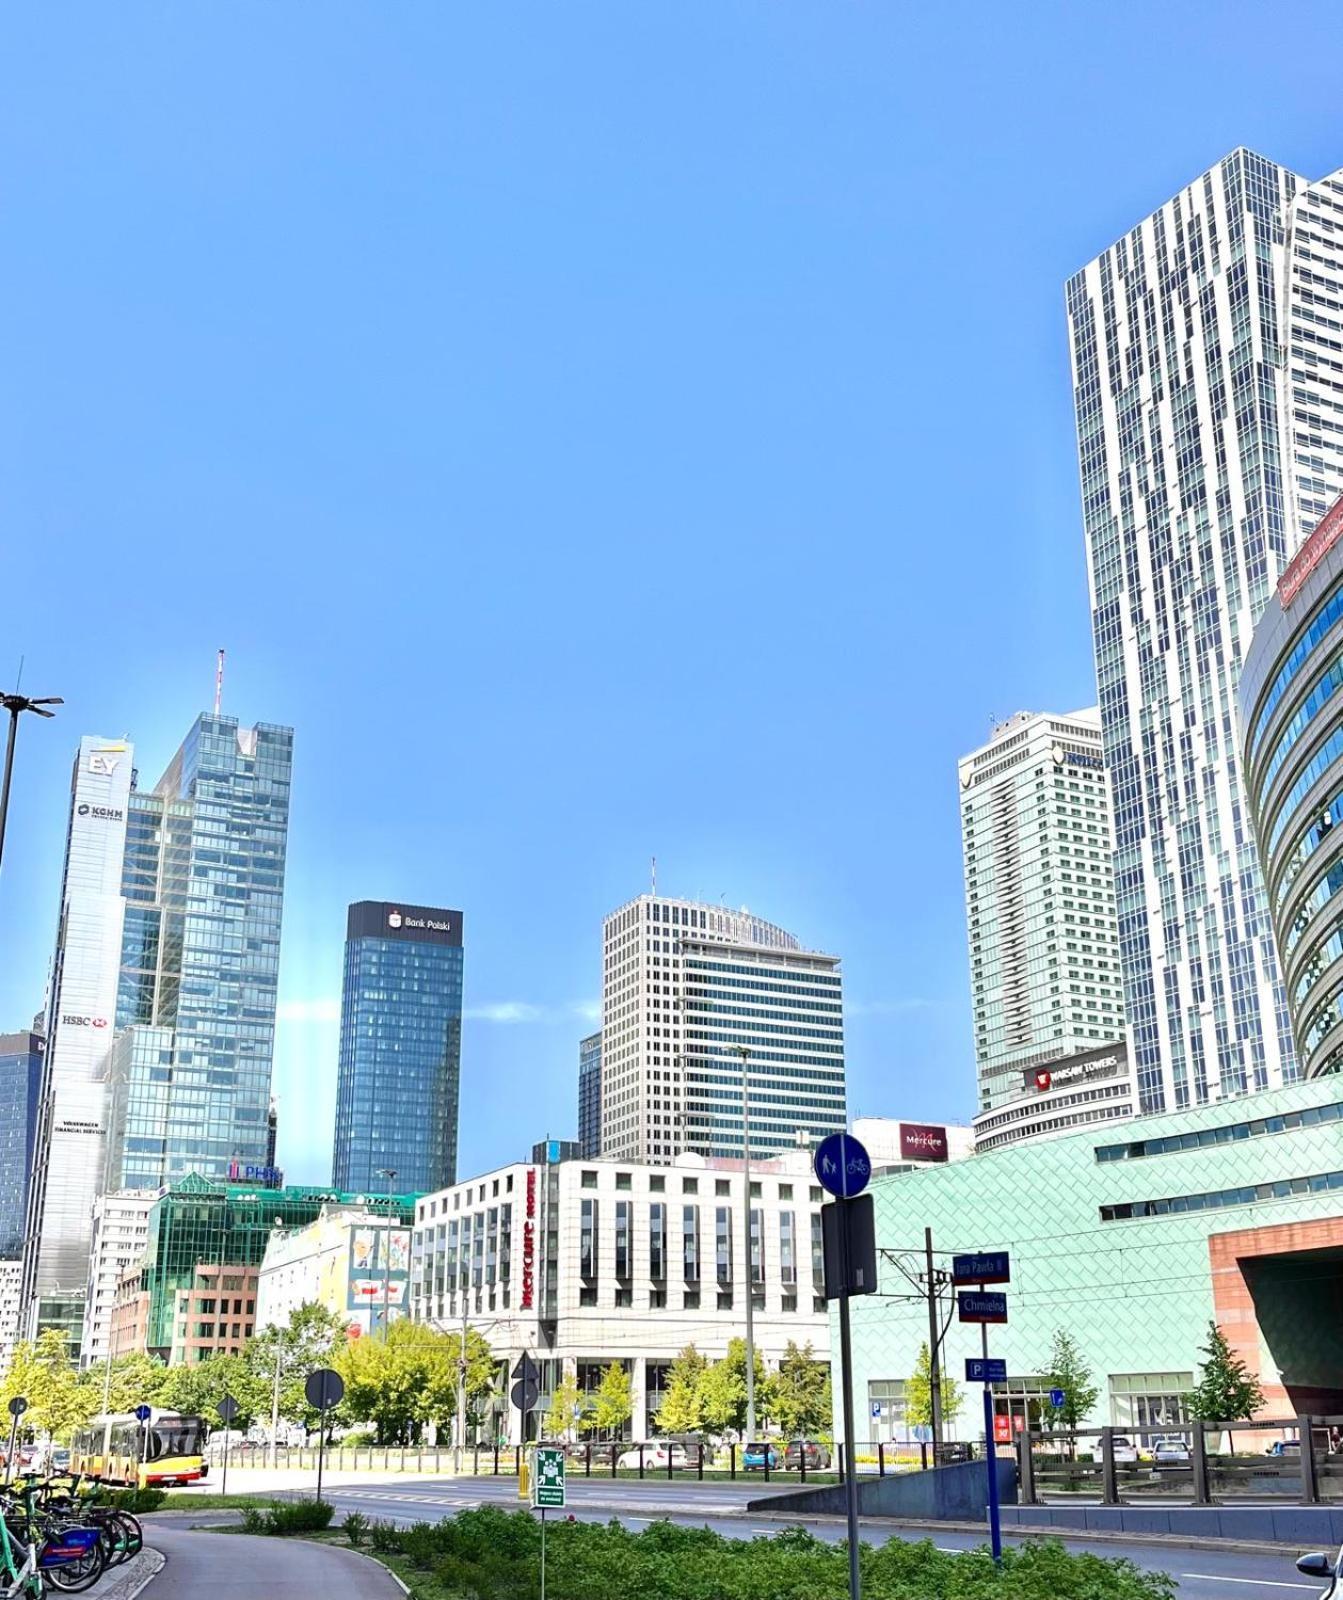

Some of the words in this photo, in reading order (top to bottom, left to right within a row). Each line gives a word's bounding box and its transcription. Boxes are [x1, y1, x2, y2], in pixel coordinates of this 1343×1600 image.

[89, 755, 120, 776] EY
[92, 806, 123, 818] KGHM
[405, 916, 426, 928] Bank
[427, 919, 451, 931] Polski
[62, 1015, 91, 1026] HSBC
[1050, 1064, 1083, 1081] WARSAW
[1083, 1055, 1118, 1073] TOWERS
[906, 1135, 942, 1147] Mercure
[963, 1297, 1005, 1313] Chmielna
